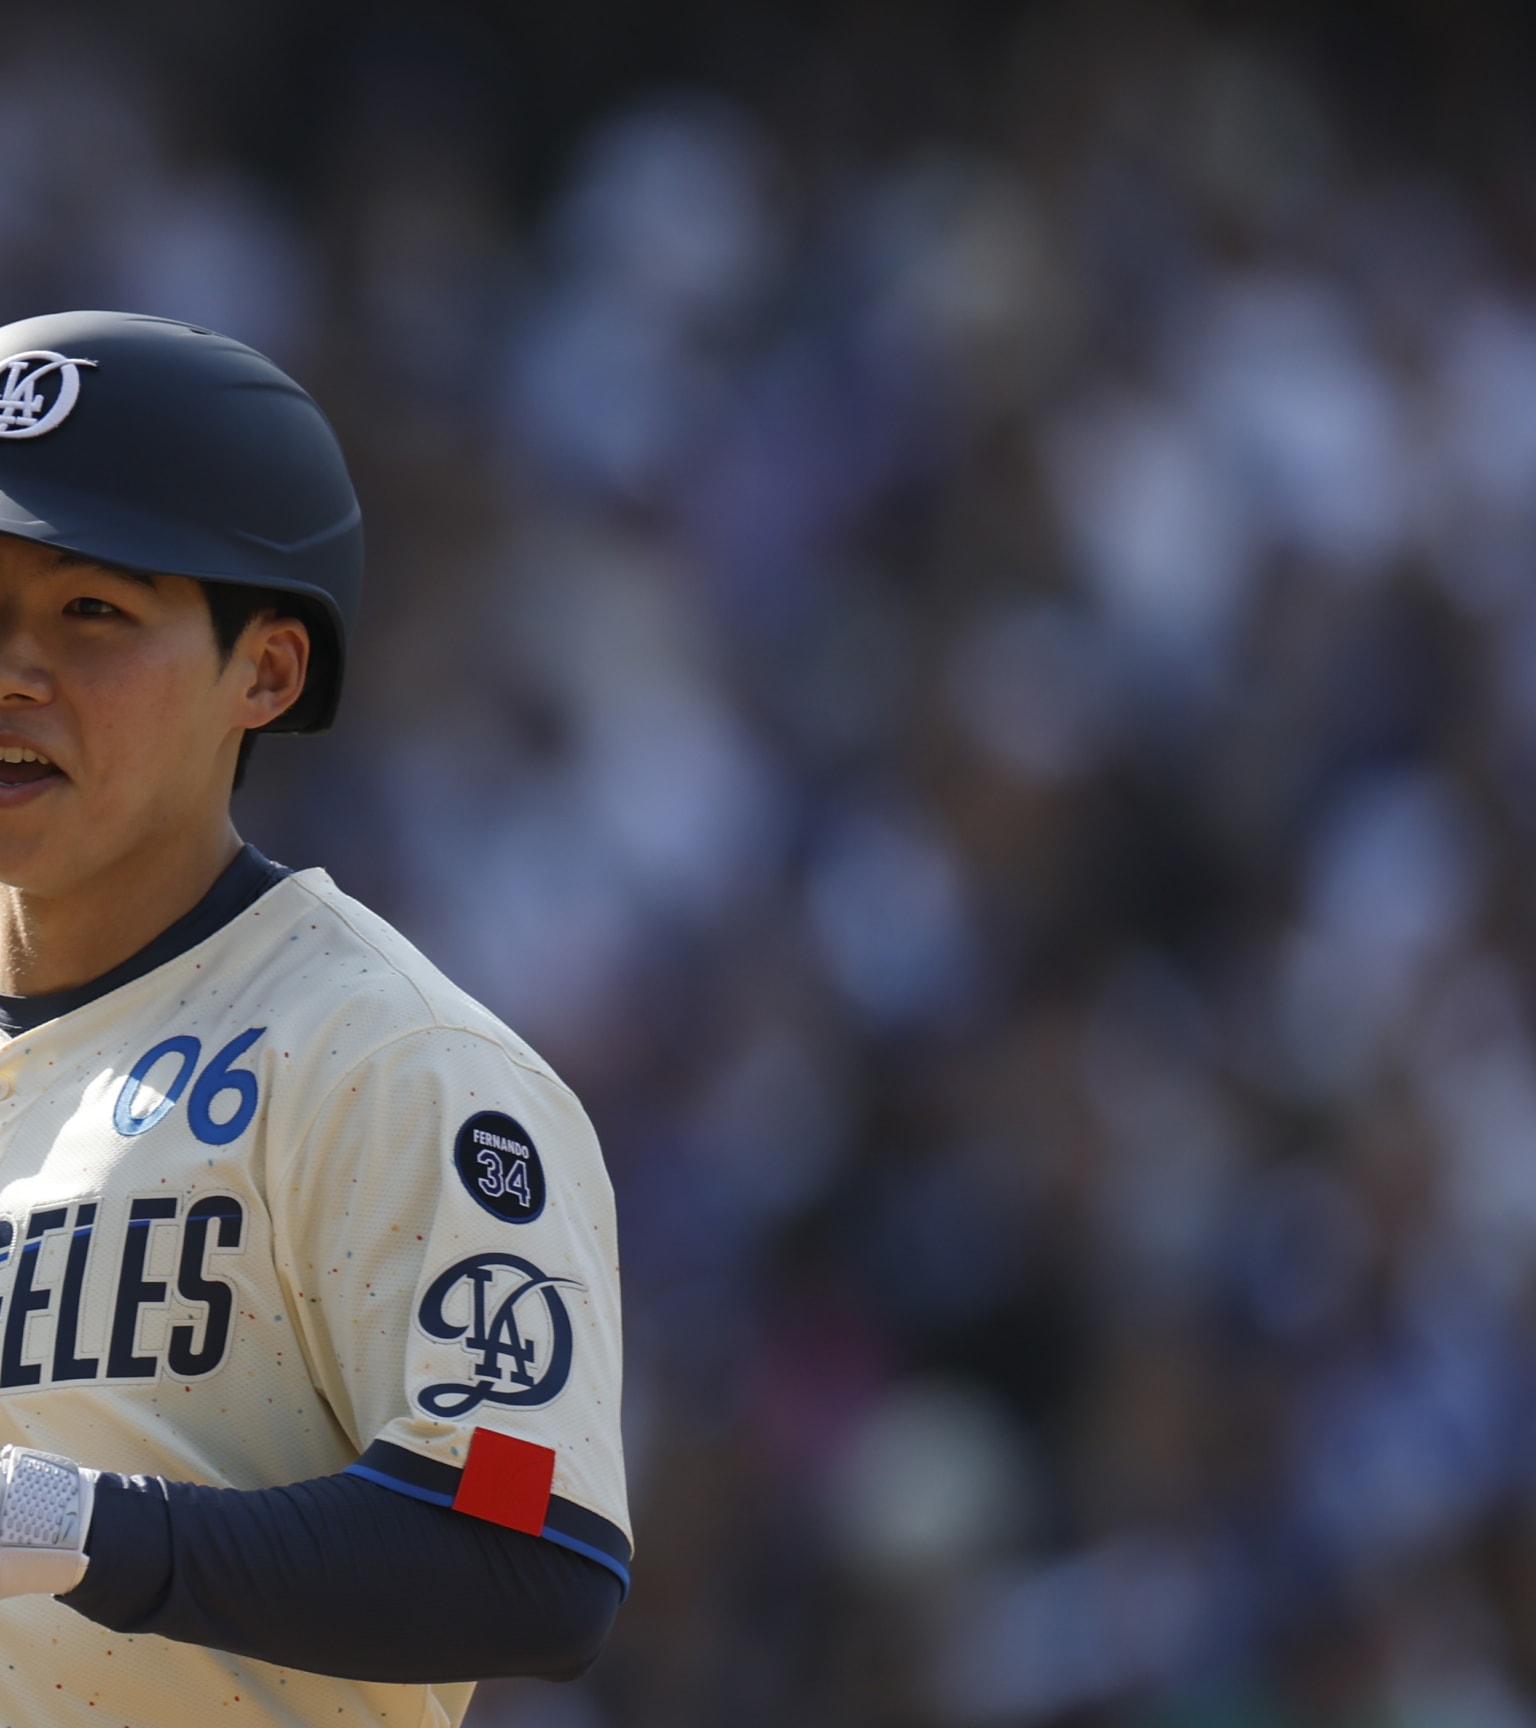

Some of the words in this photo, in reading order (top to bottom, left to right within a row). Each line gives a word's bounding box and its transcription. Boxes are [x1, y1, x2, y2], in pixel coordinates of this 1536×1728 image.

[113, 1026, 267, 1145] 06
[472, 1129, 529, 1159] FERNANDO
[476, 1148, 531, 1208] 34
